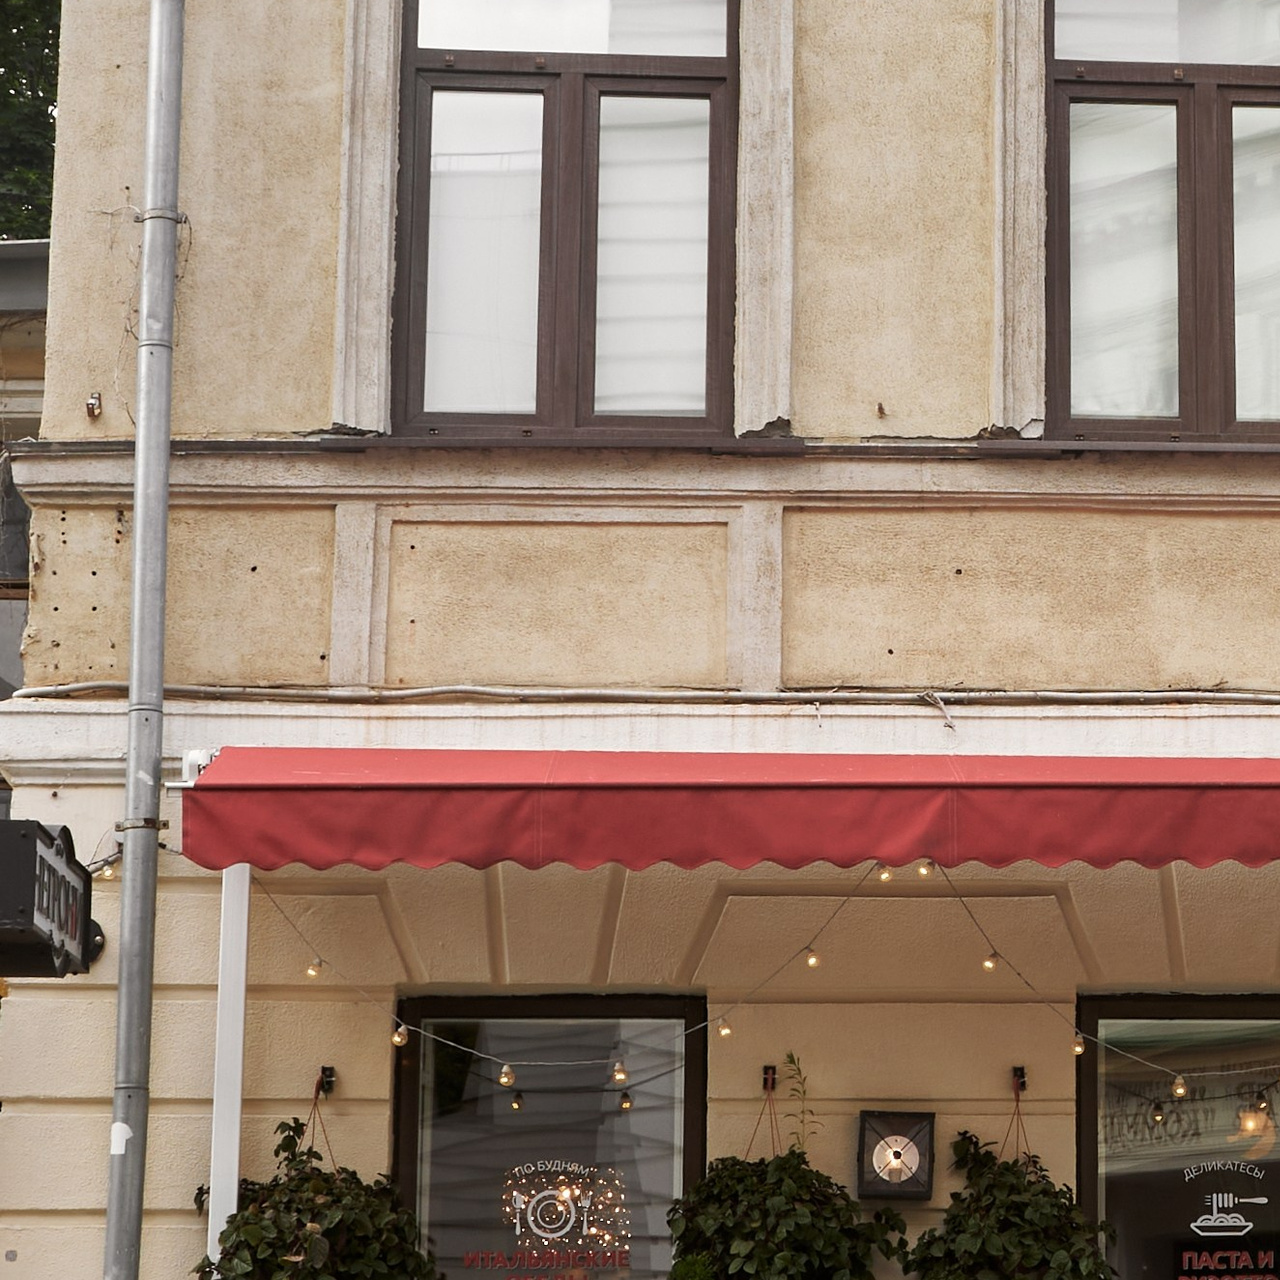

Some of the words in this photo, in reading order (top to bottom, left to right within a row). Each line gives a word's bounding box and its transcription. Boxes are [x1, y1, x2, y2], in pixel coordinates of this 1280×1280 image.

[514, 1163, 534, 1177] ПО
[537, 1160, 590, 1177] БУДНЯМ
[1183, 1160, 1265, 1182] ДЕЛИКАТЕСЫ
[463, 1249, 631, 1270] ИТАЛЬЯНСКИЕ
[1182, 1250, 1254, 1270] ПАСТА
[1258, 1250, 1275, 1269] И
